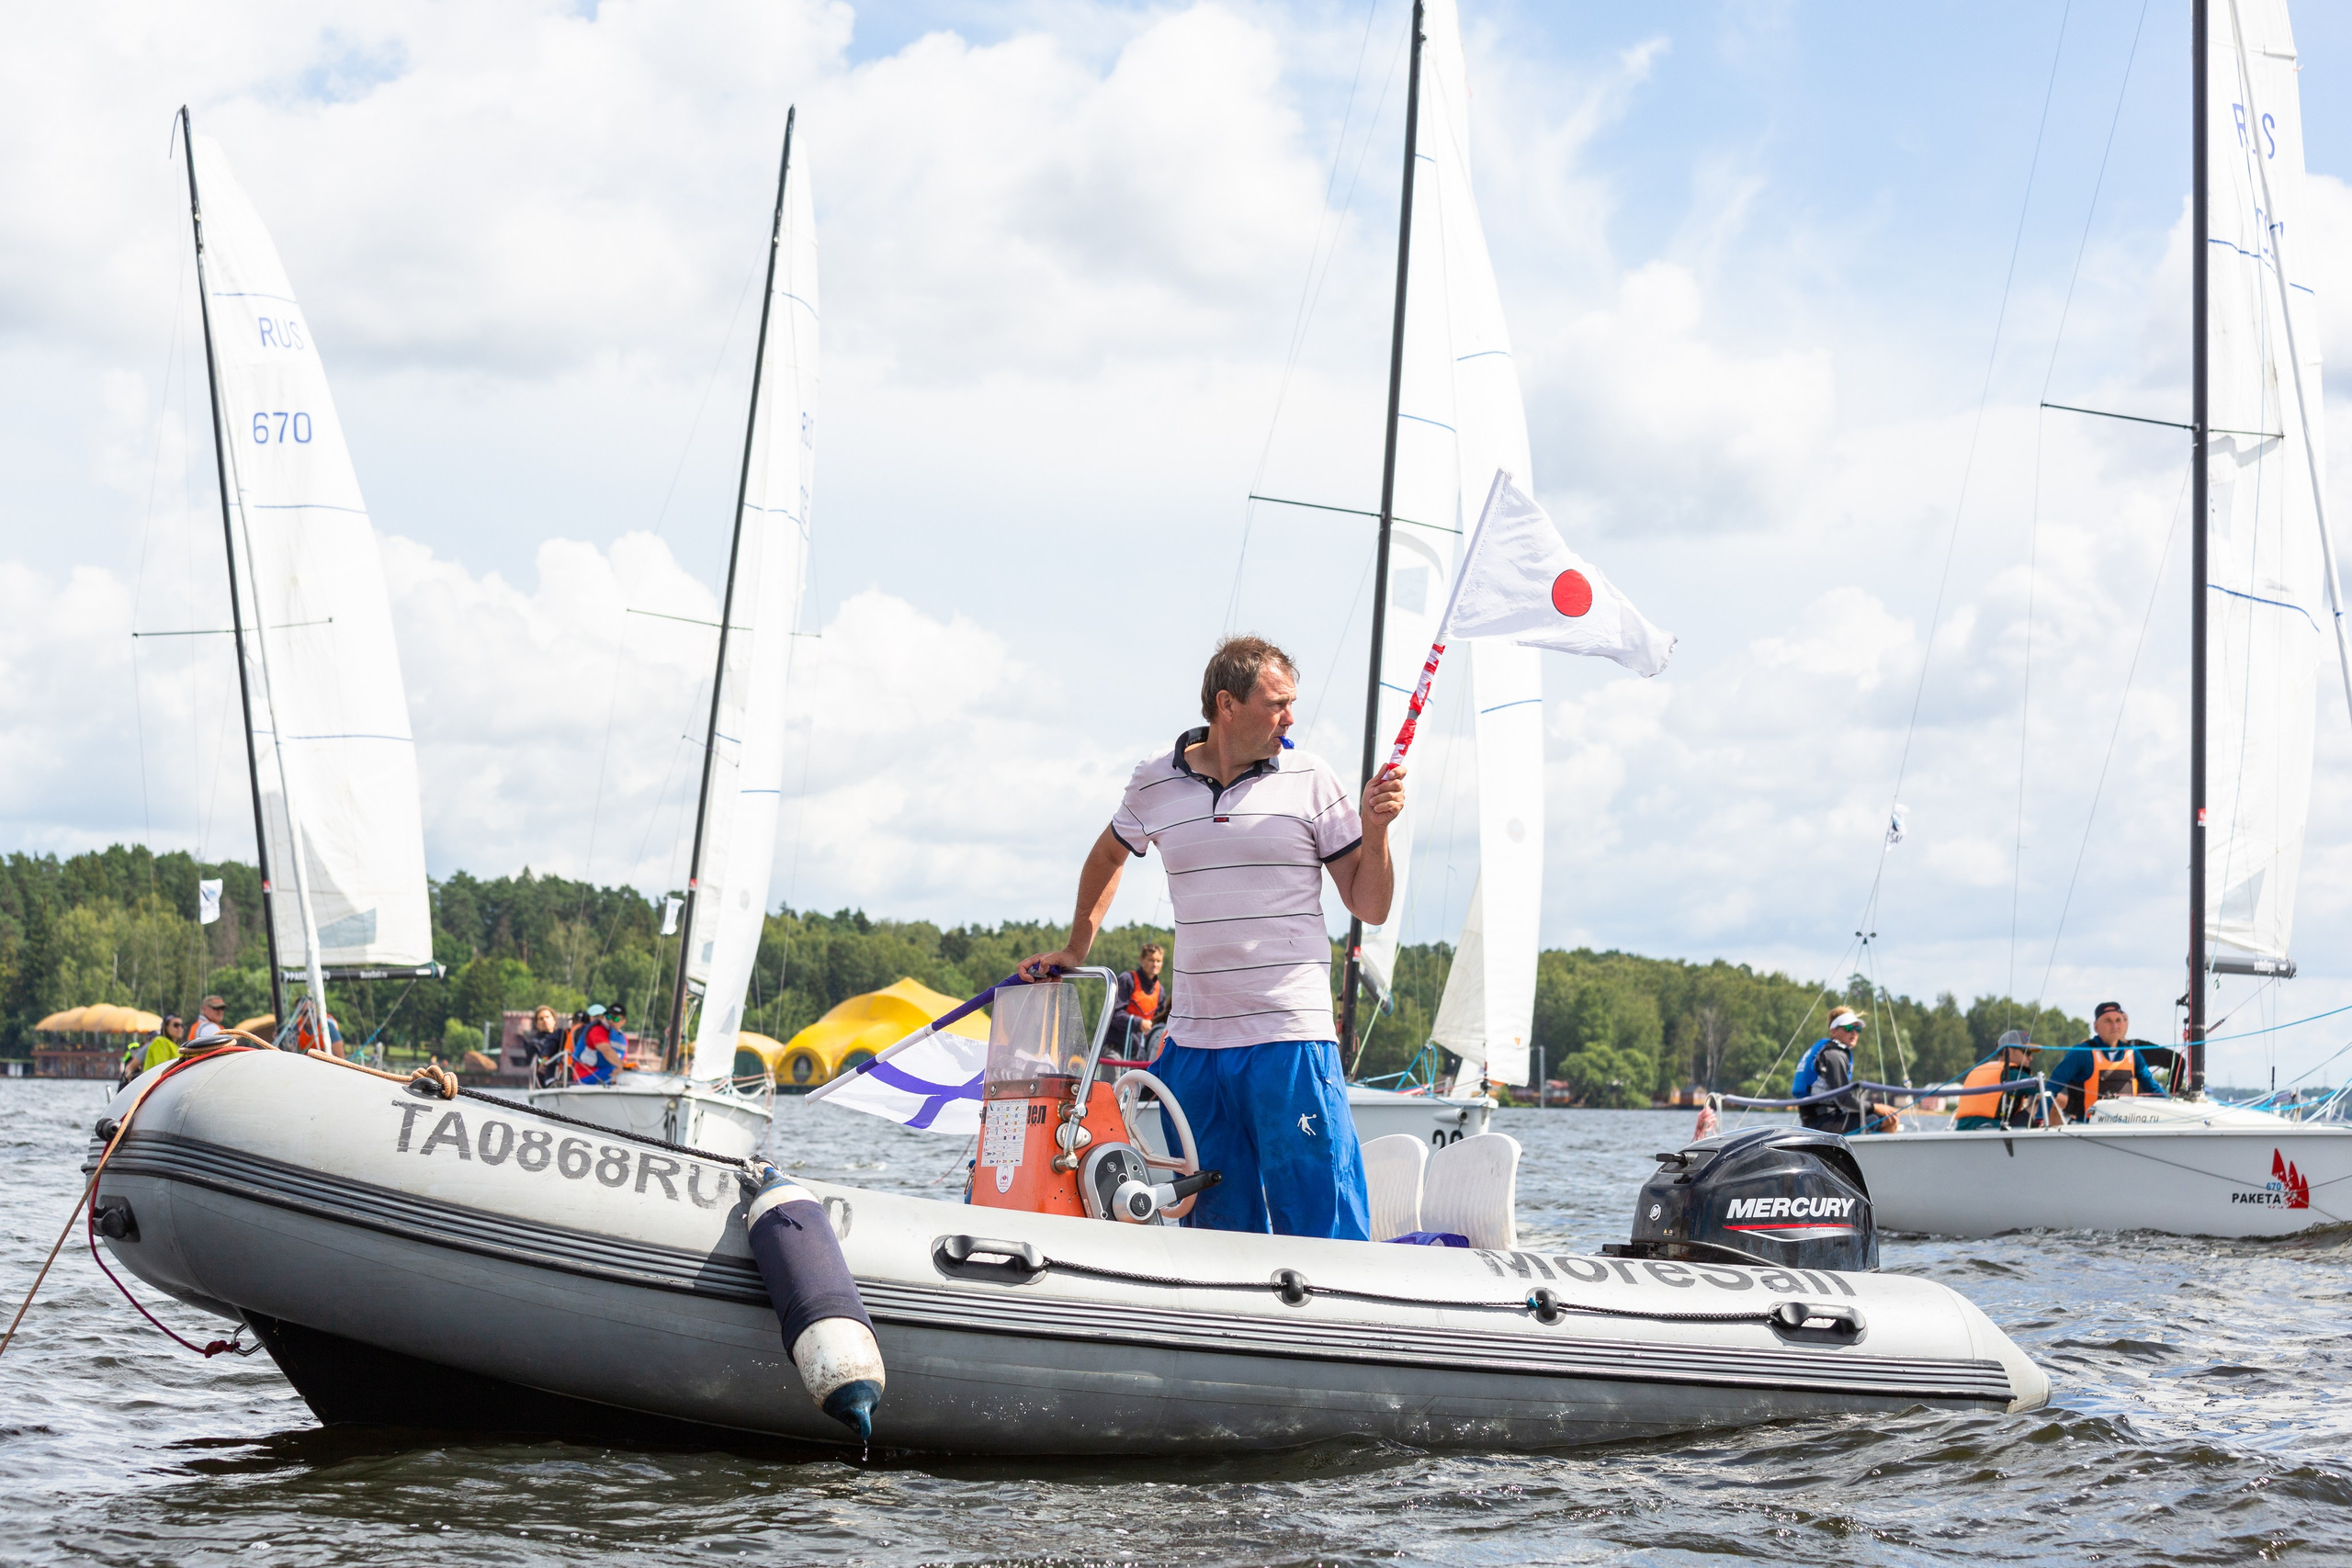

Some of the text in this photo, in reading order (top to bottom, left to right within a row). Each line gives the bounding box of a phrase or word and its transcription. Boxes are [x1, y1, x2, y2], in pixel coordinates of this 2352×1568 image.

[258, 317, 304, 350] RUS
[253, 412, 312, 444] 670
[2266, 1182, 2282, 1191] 670
[1725, 1197, 1856, 1219] MERCURY
